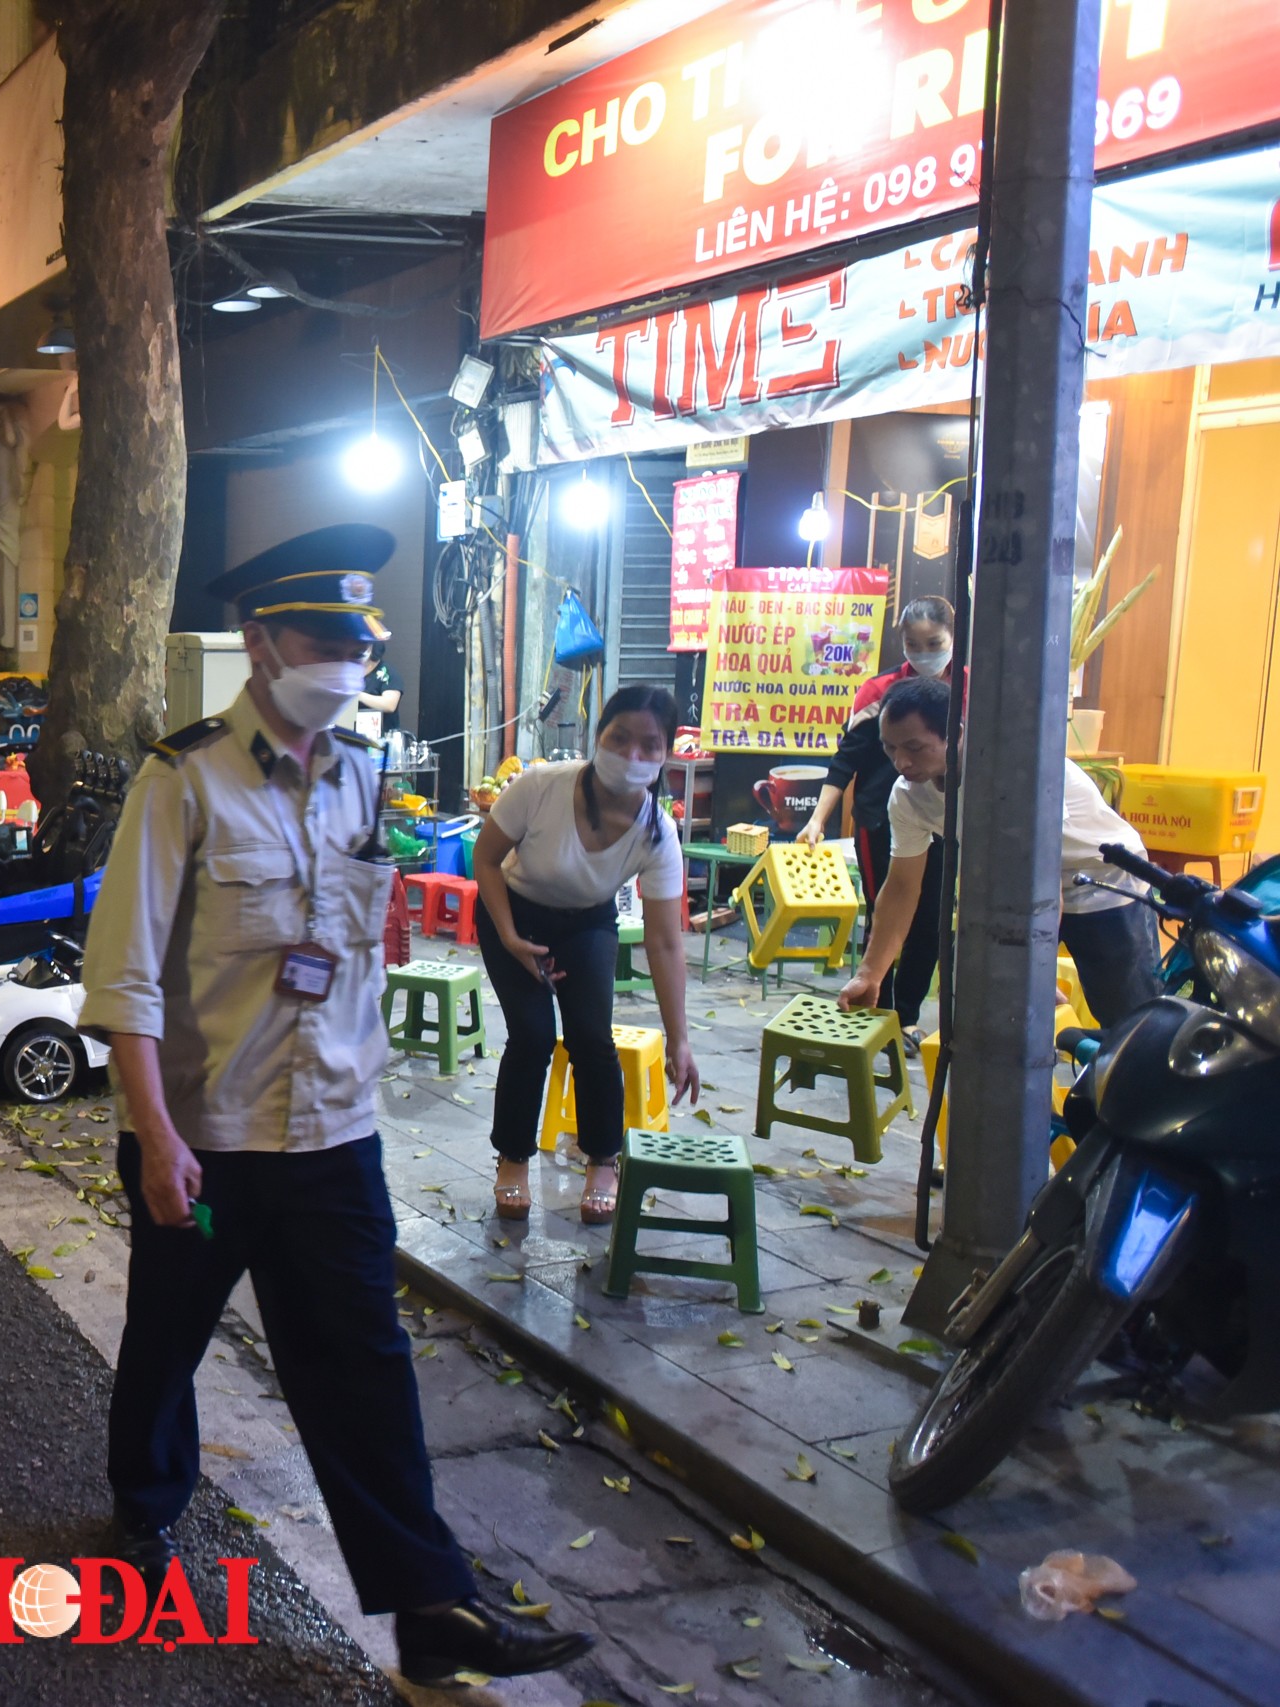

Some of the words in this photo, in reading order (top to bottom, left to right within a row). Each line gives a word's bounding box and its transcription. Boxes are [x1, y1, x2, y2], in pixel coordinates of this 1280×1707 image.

[543, 81, 666, 177] CHO
[695, 208, 774, 263] LIÊN
[785, 179, 850, 234] HỆ:
[863, 157, 937, 213] 098
[767, 566, 834, 583] TIMES
[719, 596, 746, 614] NÂU
[851, 602, 874, 617] 20K
[718, 621, 767, 645] NƯỚC
[773, 621, 796, 646] ÉP
[716, 652, 751, 672] HOA
[757, 648, 792, 674] QUẢ
[824, 645, 853, 662] 20K
[713, 680, 751, 693] NƯỚC
[756, 683, 784, 695] HOA
[789, 680, 817, 696] QUẢ
[822, 684, 849, 696] MIX
[710, 699, 760, 723] TRÀ
[711, 726, 751, 746] TRÀ
[757, 727, 786, 748] ĐÁ
[794, 727, 828, 748] VỈA
[784, 796, 818, 807] TIMES
[1153, 812, 1168, 826] HÀ
[1171, 815, 1191, 829] NỘI
